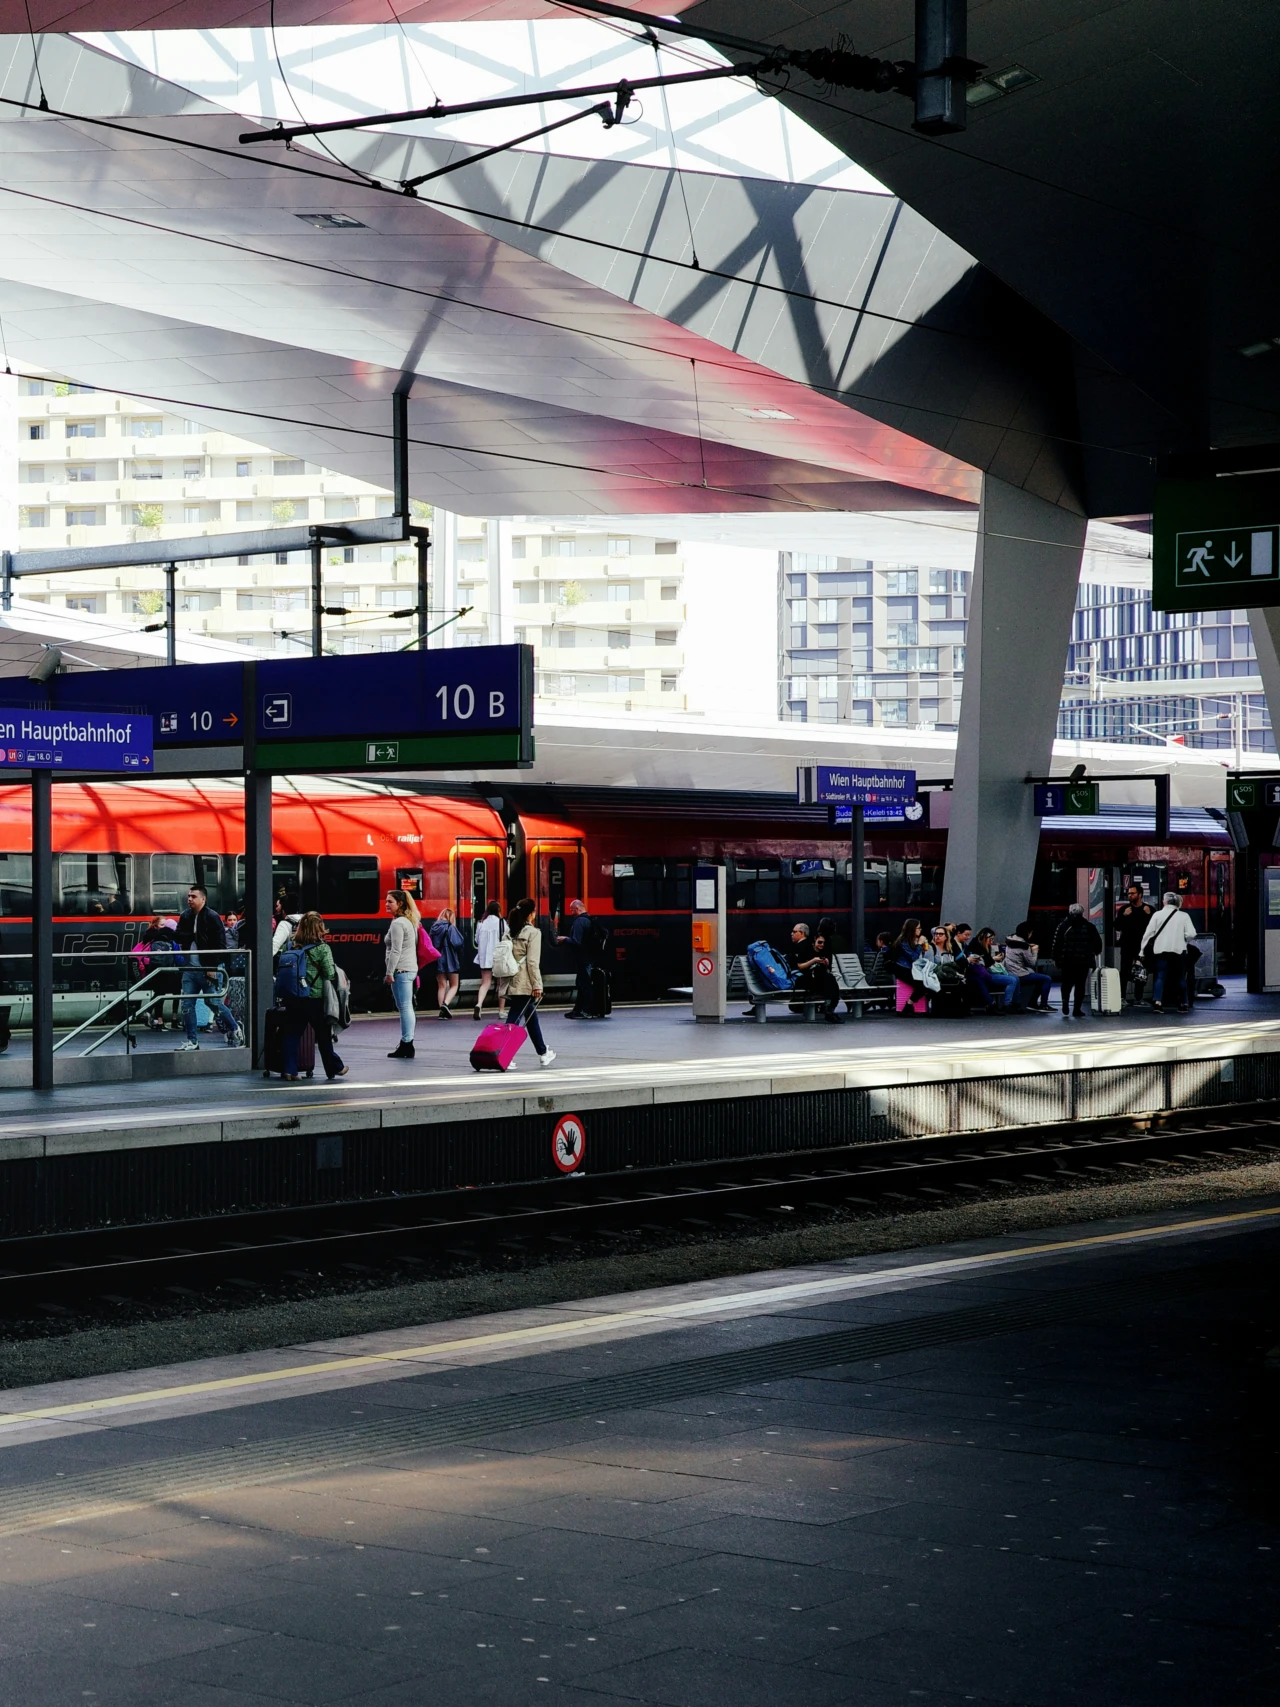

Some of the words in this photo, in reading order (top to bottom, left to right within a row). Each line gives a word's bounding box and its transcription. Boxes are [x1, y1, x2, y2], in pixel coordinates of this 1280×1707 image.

[435, 684, 475, 720] 10
[489, 691, 505, 718] B
[190, 711, 213, 731] 10
[21, 720, 132, 746] Hauptbahnhof
[9, 752, 16, 760] U1
[829, 773, 850, 787] Wien
[851, 774, 906, 790] Hauptbahnhof
[1239, 785, 1253, 793] SOS
[397, 833, 424, 844] railjet
[474, 871, 484, 886] 2
[551, 870, 562, 885] 2
[323, 933, 381, 945] economy
